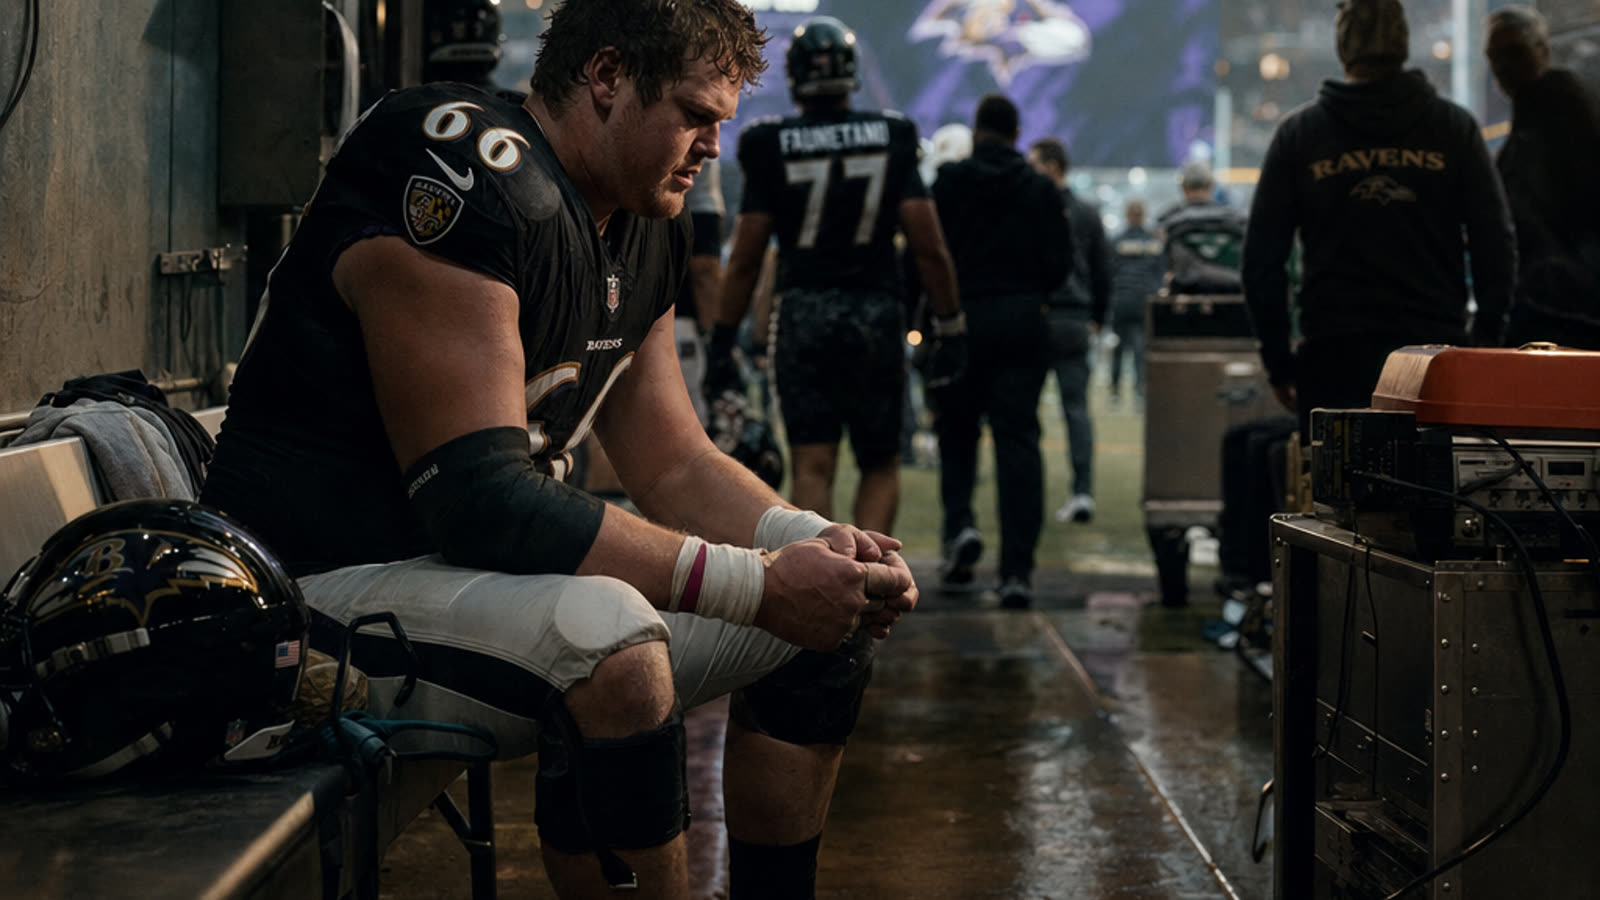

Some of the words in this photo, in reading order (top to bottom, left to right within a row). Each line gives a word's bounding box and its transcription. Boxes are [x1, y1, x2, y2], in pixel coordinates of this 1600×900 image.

[422, 100, 532, 173] 66
[1309, 147, 1447, 180] RAVENS
[785, 153, 888, 248] 77
